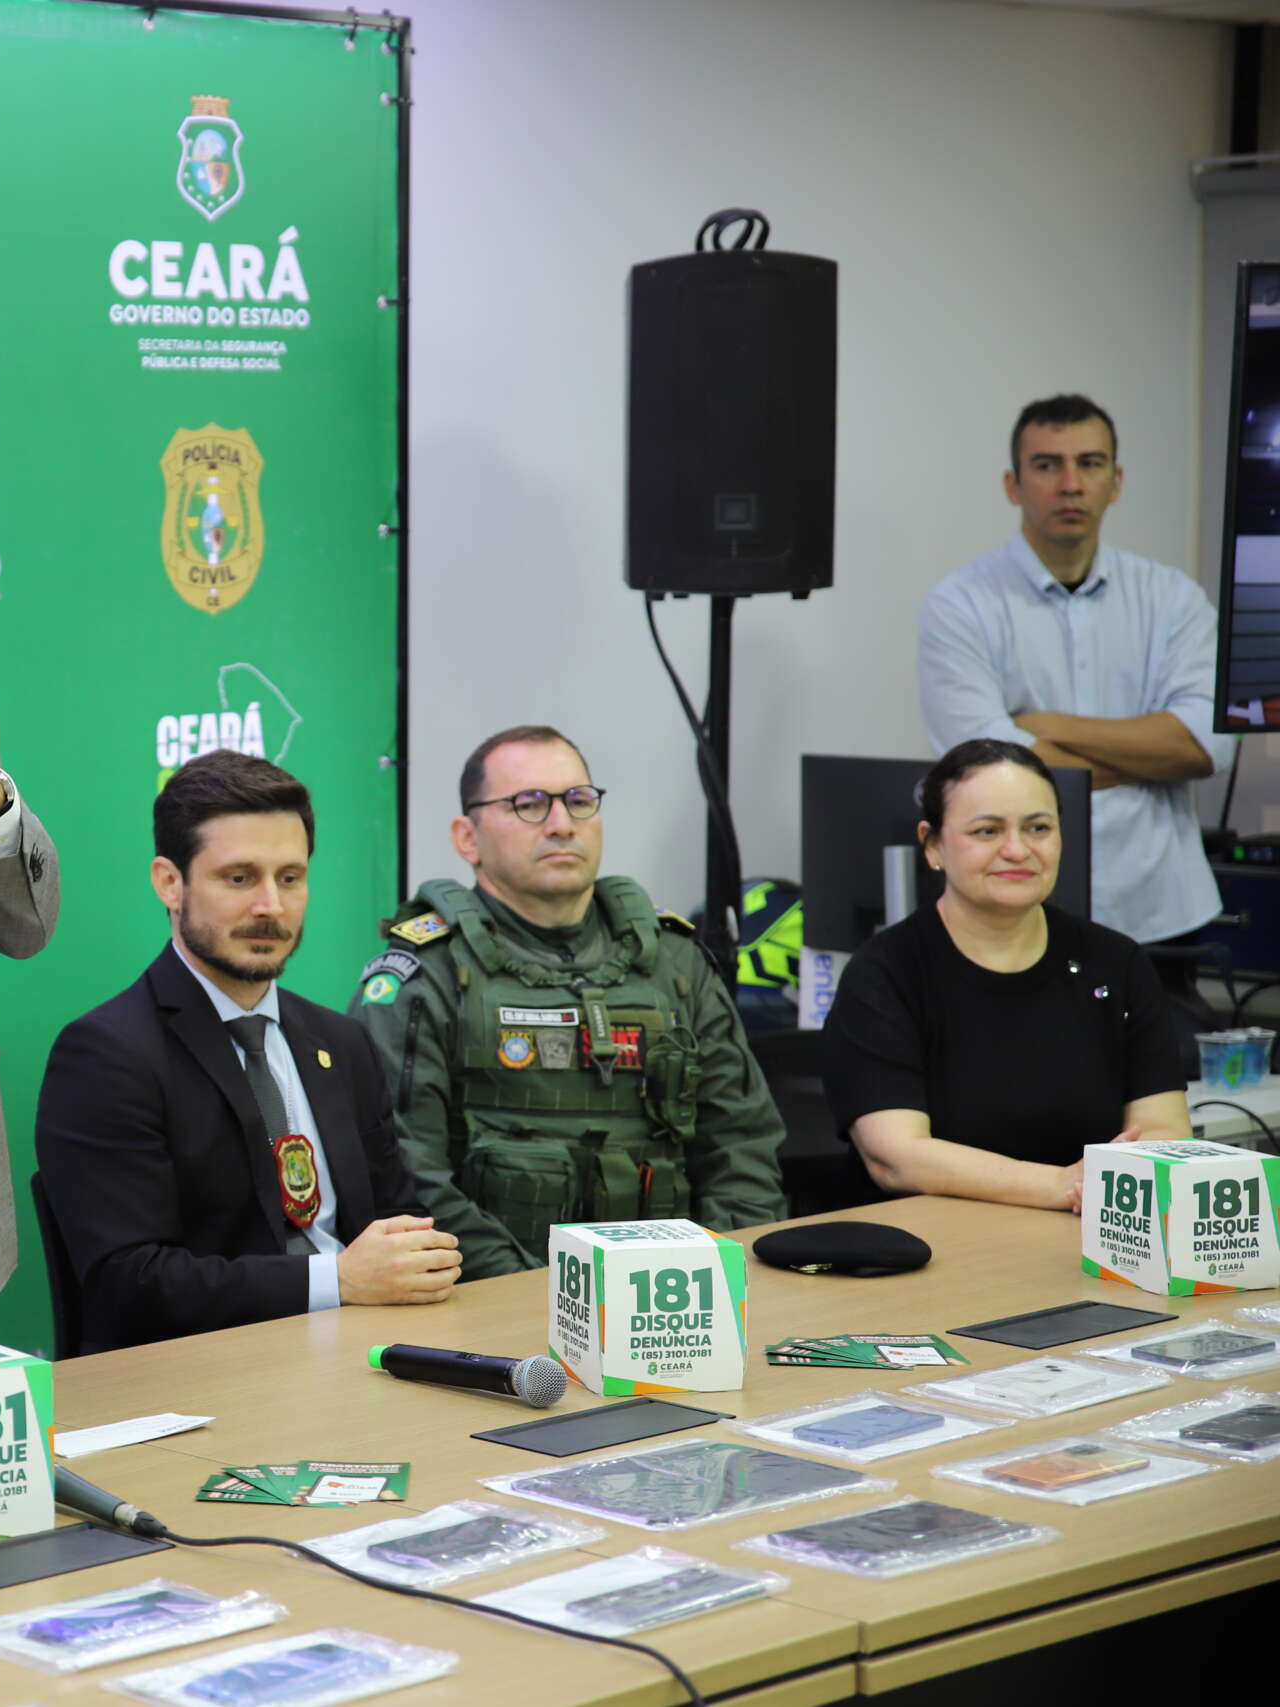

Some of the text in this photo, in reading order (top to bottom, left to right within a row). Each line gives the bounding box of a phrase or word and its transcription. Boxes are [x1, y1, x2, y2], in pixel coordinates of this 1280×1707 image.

[108, 225, 310, 301] CEARÁ
[109, 304, 310, 327] GOVERNO DO ESTADO
[138, 338, 287, 355] SECRETARIA DA SEGURANÇA
[141, 353, 189, 367] PÚBLICA
[199, 357, 240, 368] DEFESA
[242, 358, 280, 369] SOCIAL
[188, 565, 236, 584] CIVIL
[156, 702, 265, 768] CEARÁ
[1102, 1171, 1152, 1218] 181
[1193, 1177, 1259, 1219] 181
[1100, 1208, 1150, 1234] DISQUE
[1193, 1218, 1259, 1237] DISQUE
[1100, 1227, 1150, 1249] DENÚNCIA
[1194, 1235, 1259, 1251] DENÚNCIA
[1203, 1251, 1259, 1262] (85) 3101.0181
[1218, 1260, 1244, 1271] CEARÁ
[558, 1251, 590, 1305] 181
[629, 1267, 713, 1313] 181
[558, 1293, 590, 1324] DISQUE
[558, 1314, 589, 1340] DENÚNCIA
[631, 1313, 712, 1334] DISQUE
[630, 1332, 712, 1349] DENÚNCIA
[641, 1349, 712, 1360] (85) 3101.0181
[660, 1360, 693, 1370] CEARÁ
